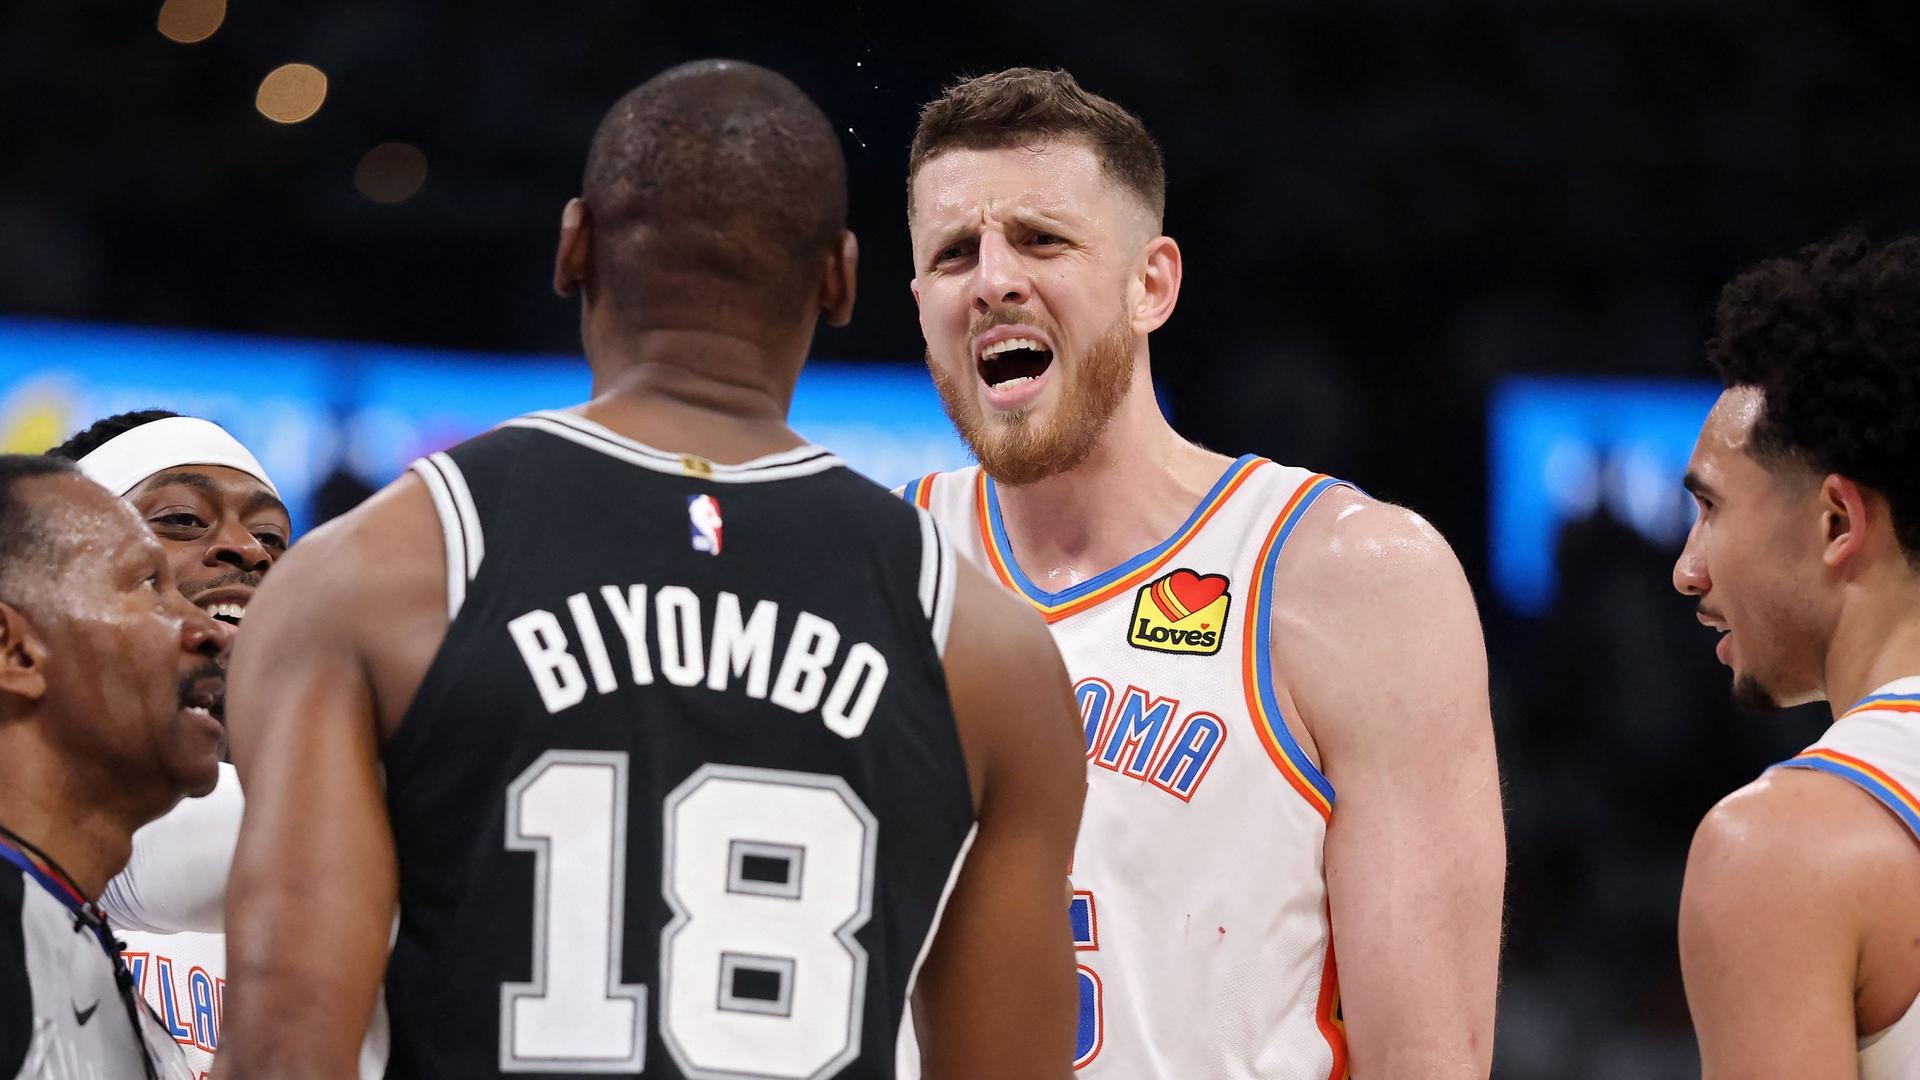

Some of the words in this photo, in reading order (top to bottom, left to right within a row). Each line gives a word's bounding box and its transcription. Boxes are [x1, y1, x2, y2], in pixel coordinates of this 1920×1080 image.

[507, 583, 889, 739] BIYOMBO
[499, 749, 879, 1080] 18
[119, 952, 226, 1055] LA
